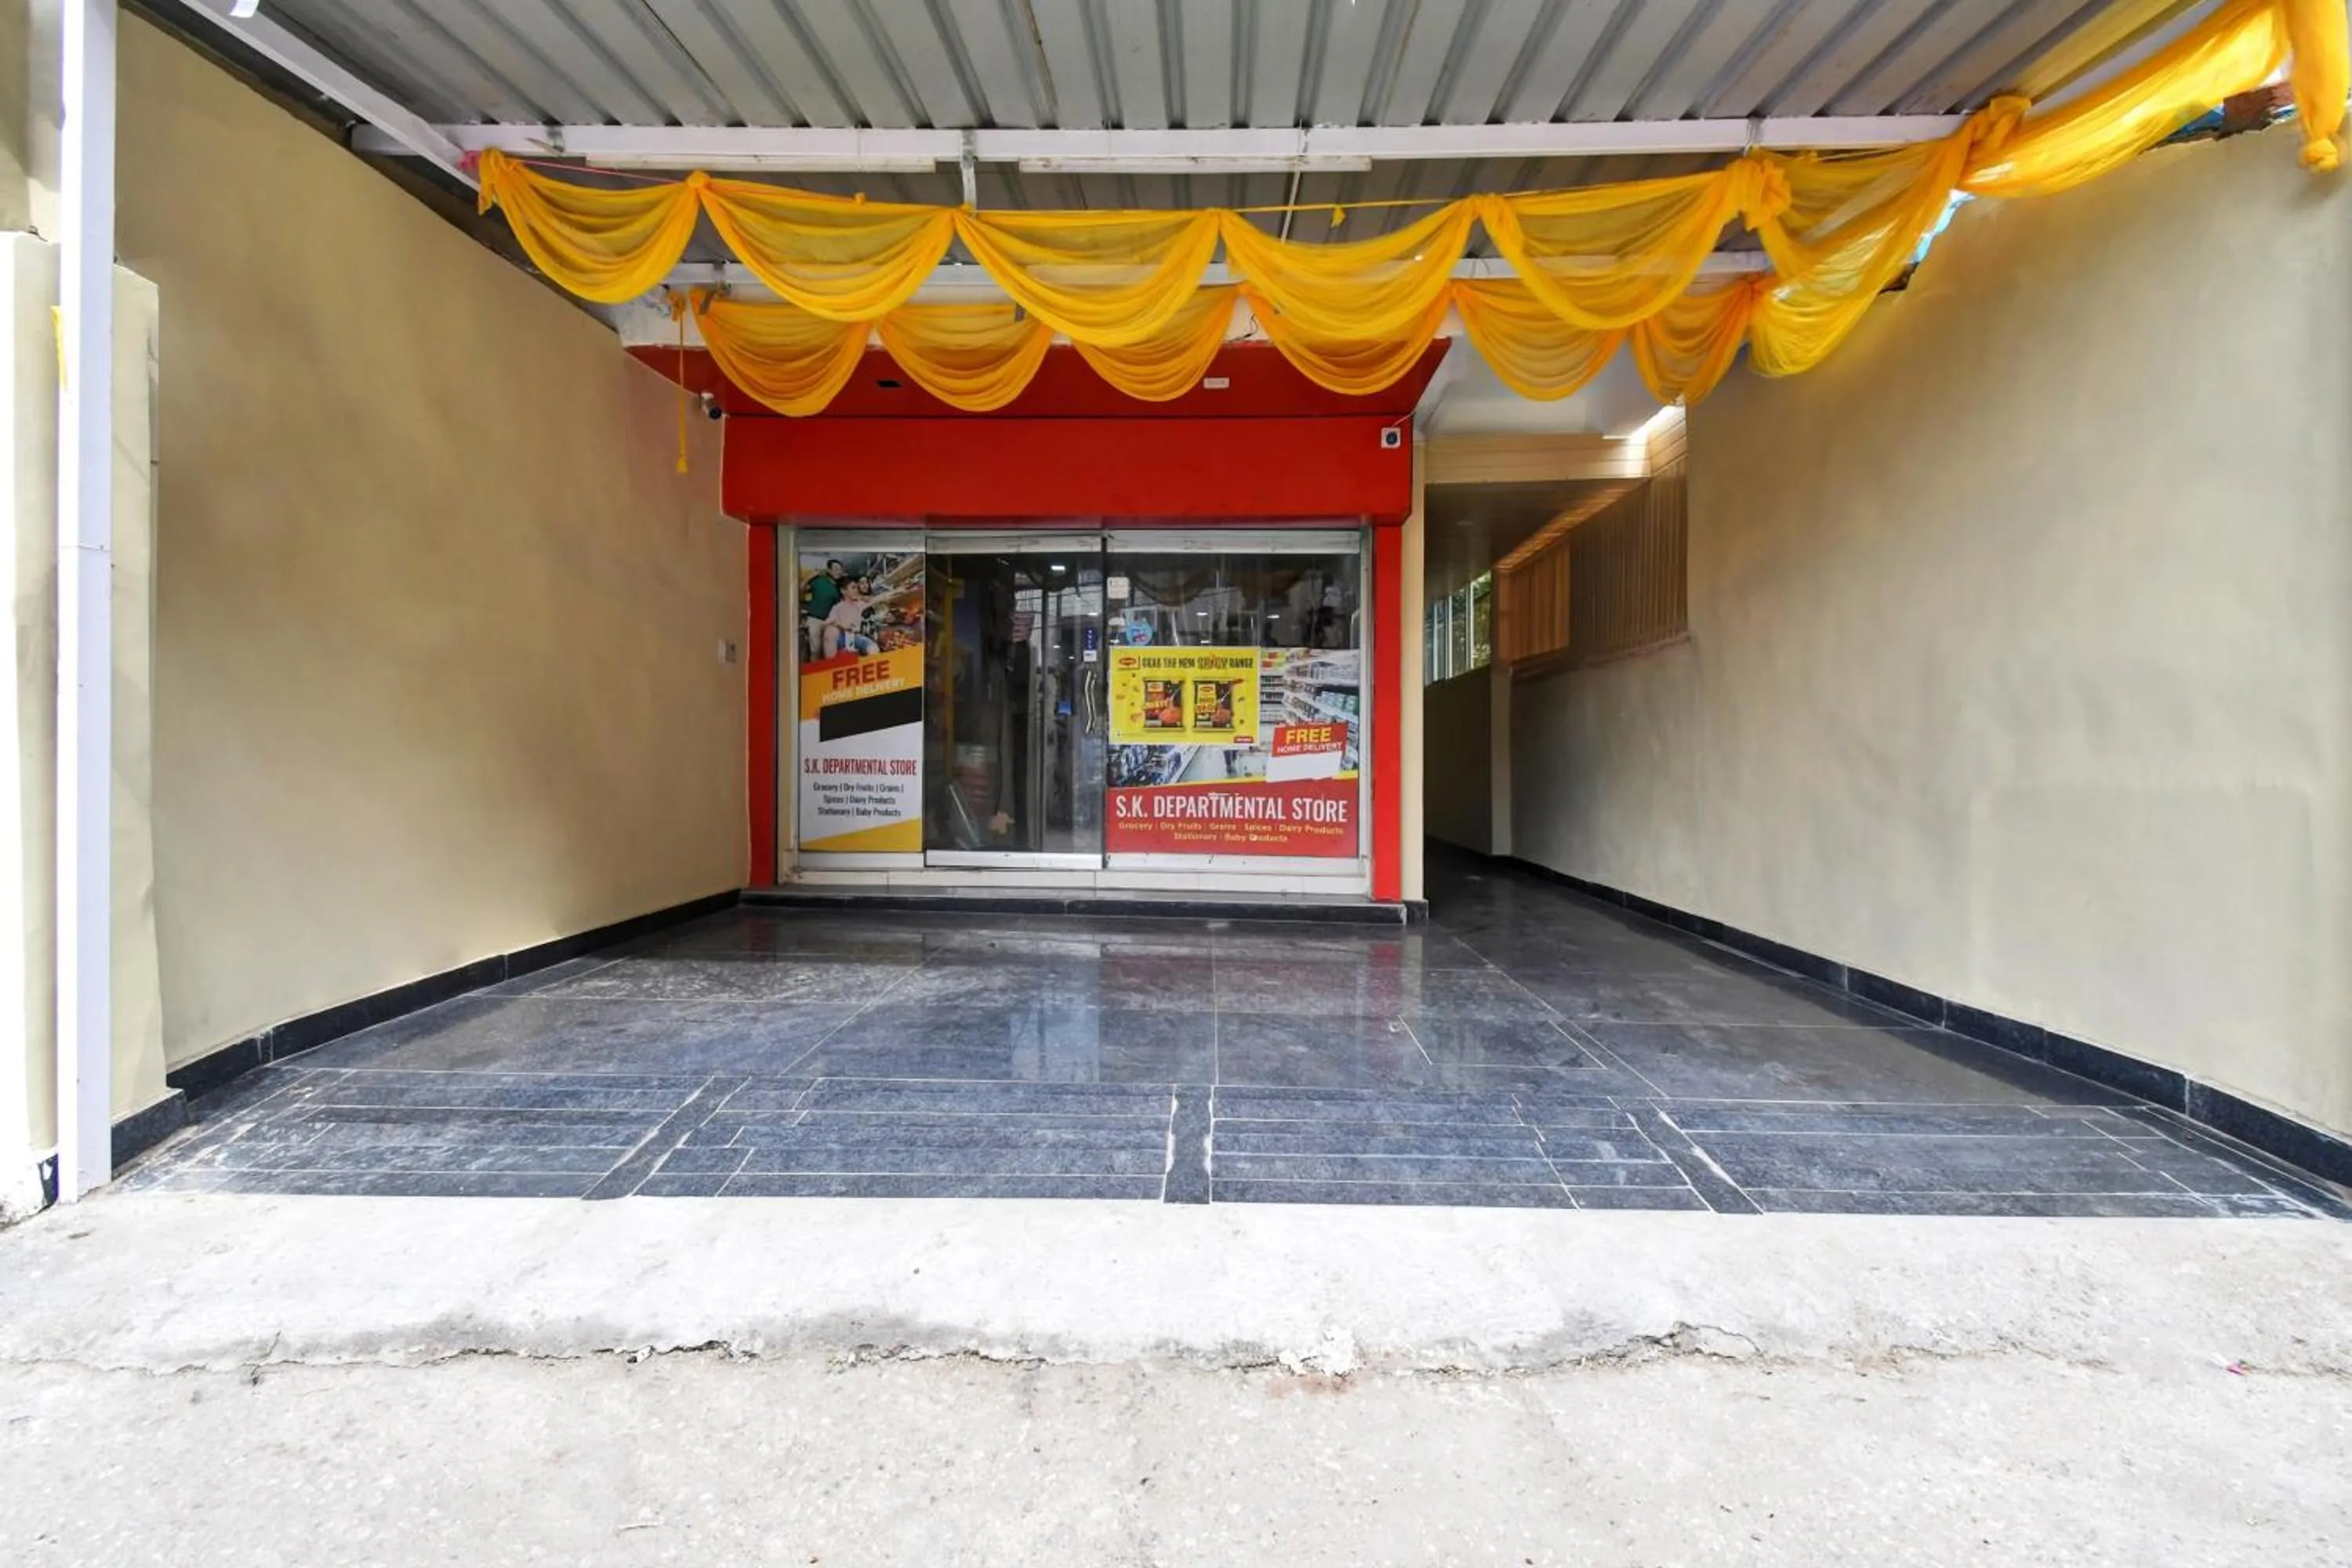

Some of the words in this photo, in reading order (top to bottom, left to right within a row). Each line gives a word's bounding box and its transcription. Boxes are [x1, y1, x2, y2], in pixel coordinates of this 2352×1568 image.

[832, 660, 890, 689] FREE
[1286, 727, 1331, 743] FREE
[1277, 744, 1301, 753] HOME
[1303, 742, 1343, 753] DELIVERY
[804, 758, 820, 774] S.K.
[823, 758, 887, 775] DEPARTMENTAL
[890, 760, 917, 775] STORE
[1116, 795, 1148, 818] S.K.
[1153, 795, 1287, 819] DEPARTMENTAL
[1292, 797, 1348, 822] STORE
[1279, 824, 1301, 833] Dairy
[1305, 825, 1344, 834] Products
